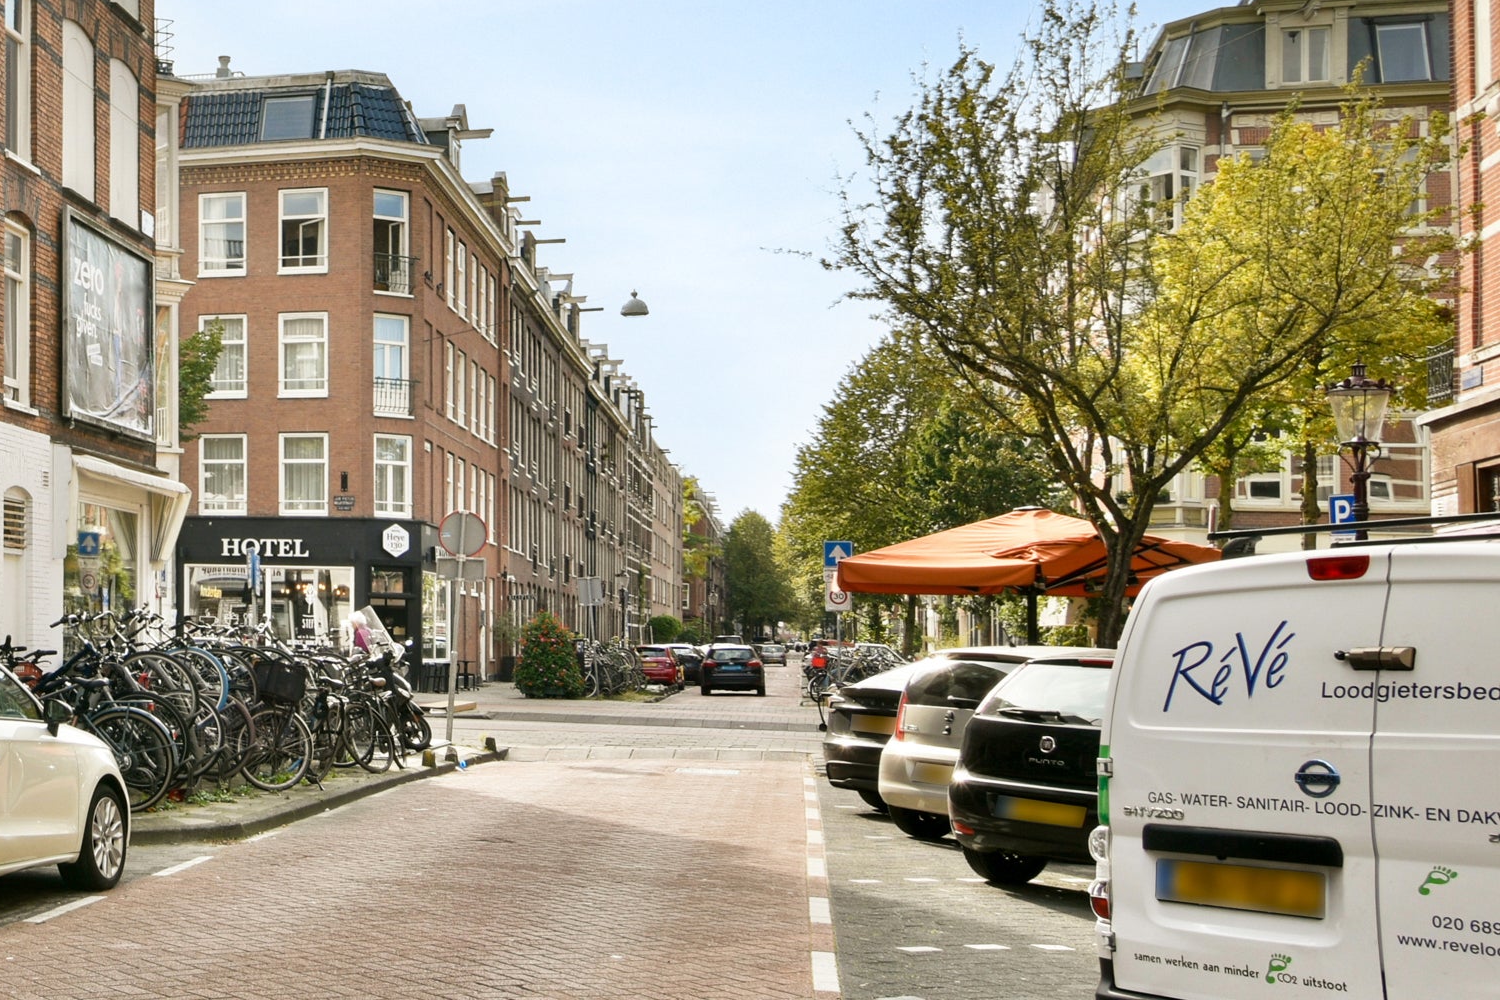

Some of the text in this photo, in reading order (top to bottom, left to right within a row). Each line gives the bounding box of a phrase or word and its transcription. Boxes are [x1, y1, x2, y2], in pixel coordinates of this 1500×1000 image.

[74, 257, 104, 295] zero
[1334, 499, 1351, 525] P
[221, 538, 309, 557] HOTEL
[1163, 620, 1295, 712] RéVé
[1028, 757, 1065, 766] PUNTO
[1148, 792, 1177, 804] GAS-
[1180, 793, 1232, 807] WATER-
[1236, 796, 1310, 813] SANITAIR-
[1315, 801, 1367, 817] LOOD-
[1373, 804, 1420, 820] ZINK-
[1425, 807, 1450, 822] EN
[1432, 915, 1464, 931] 020
[1134, 952, 1348, 993] samen werken aan minder CO2 uitstoot
